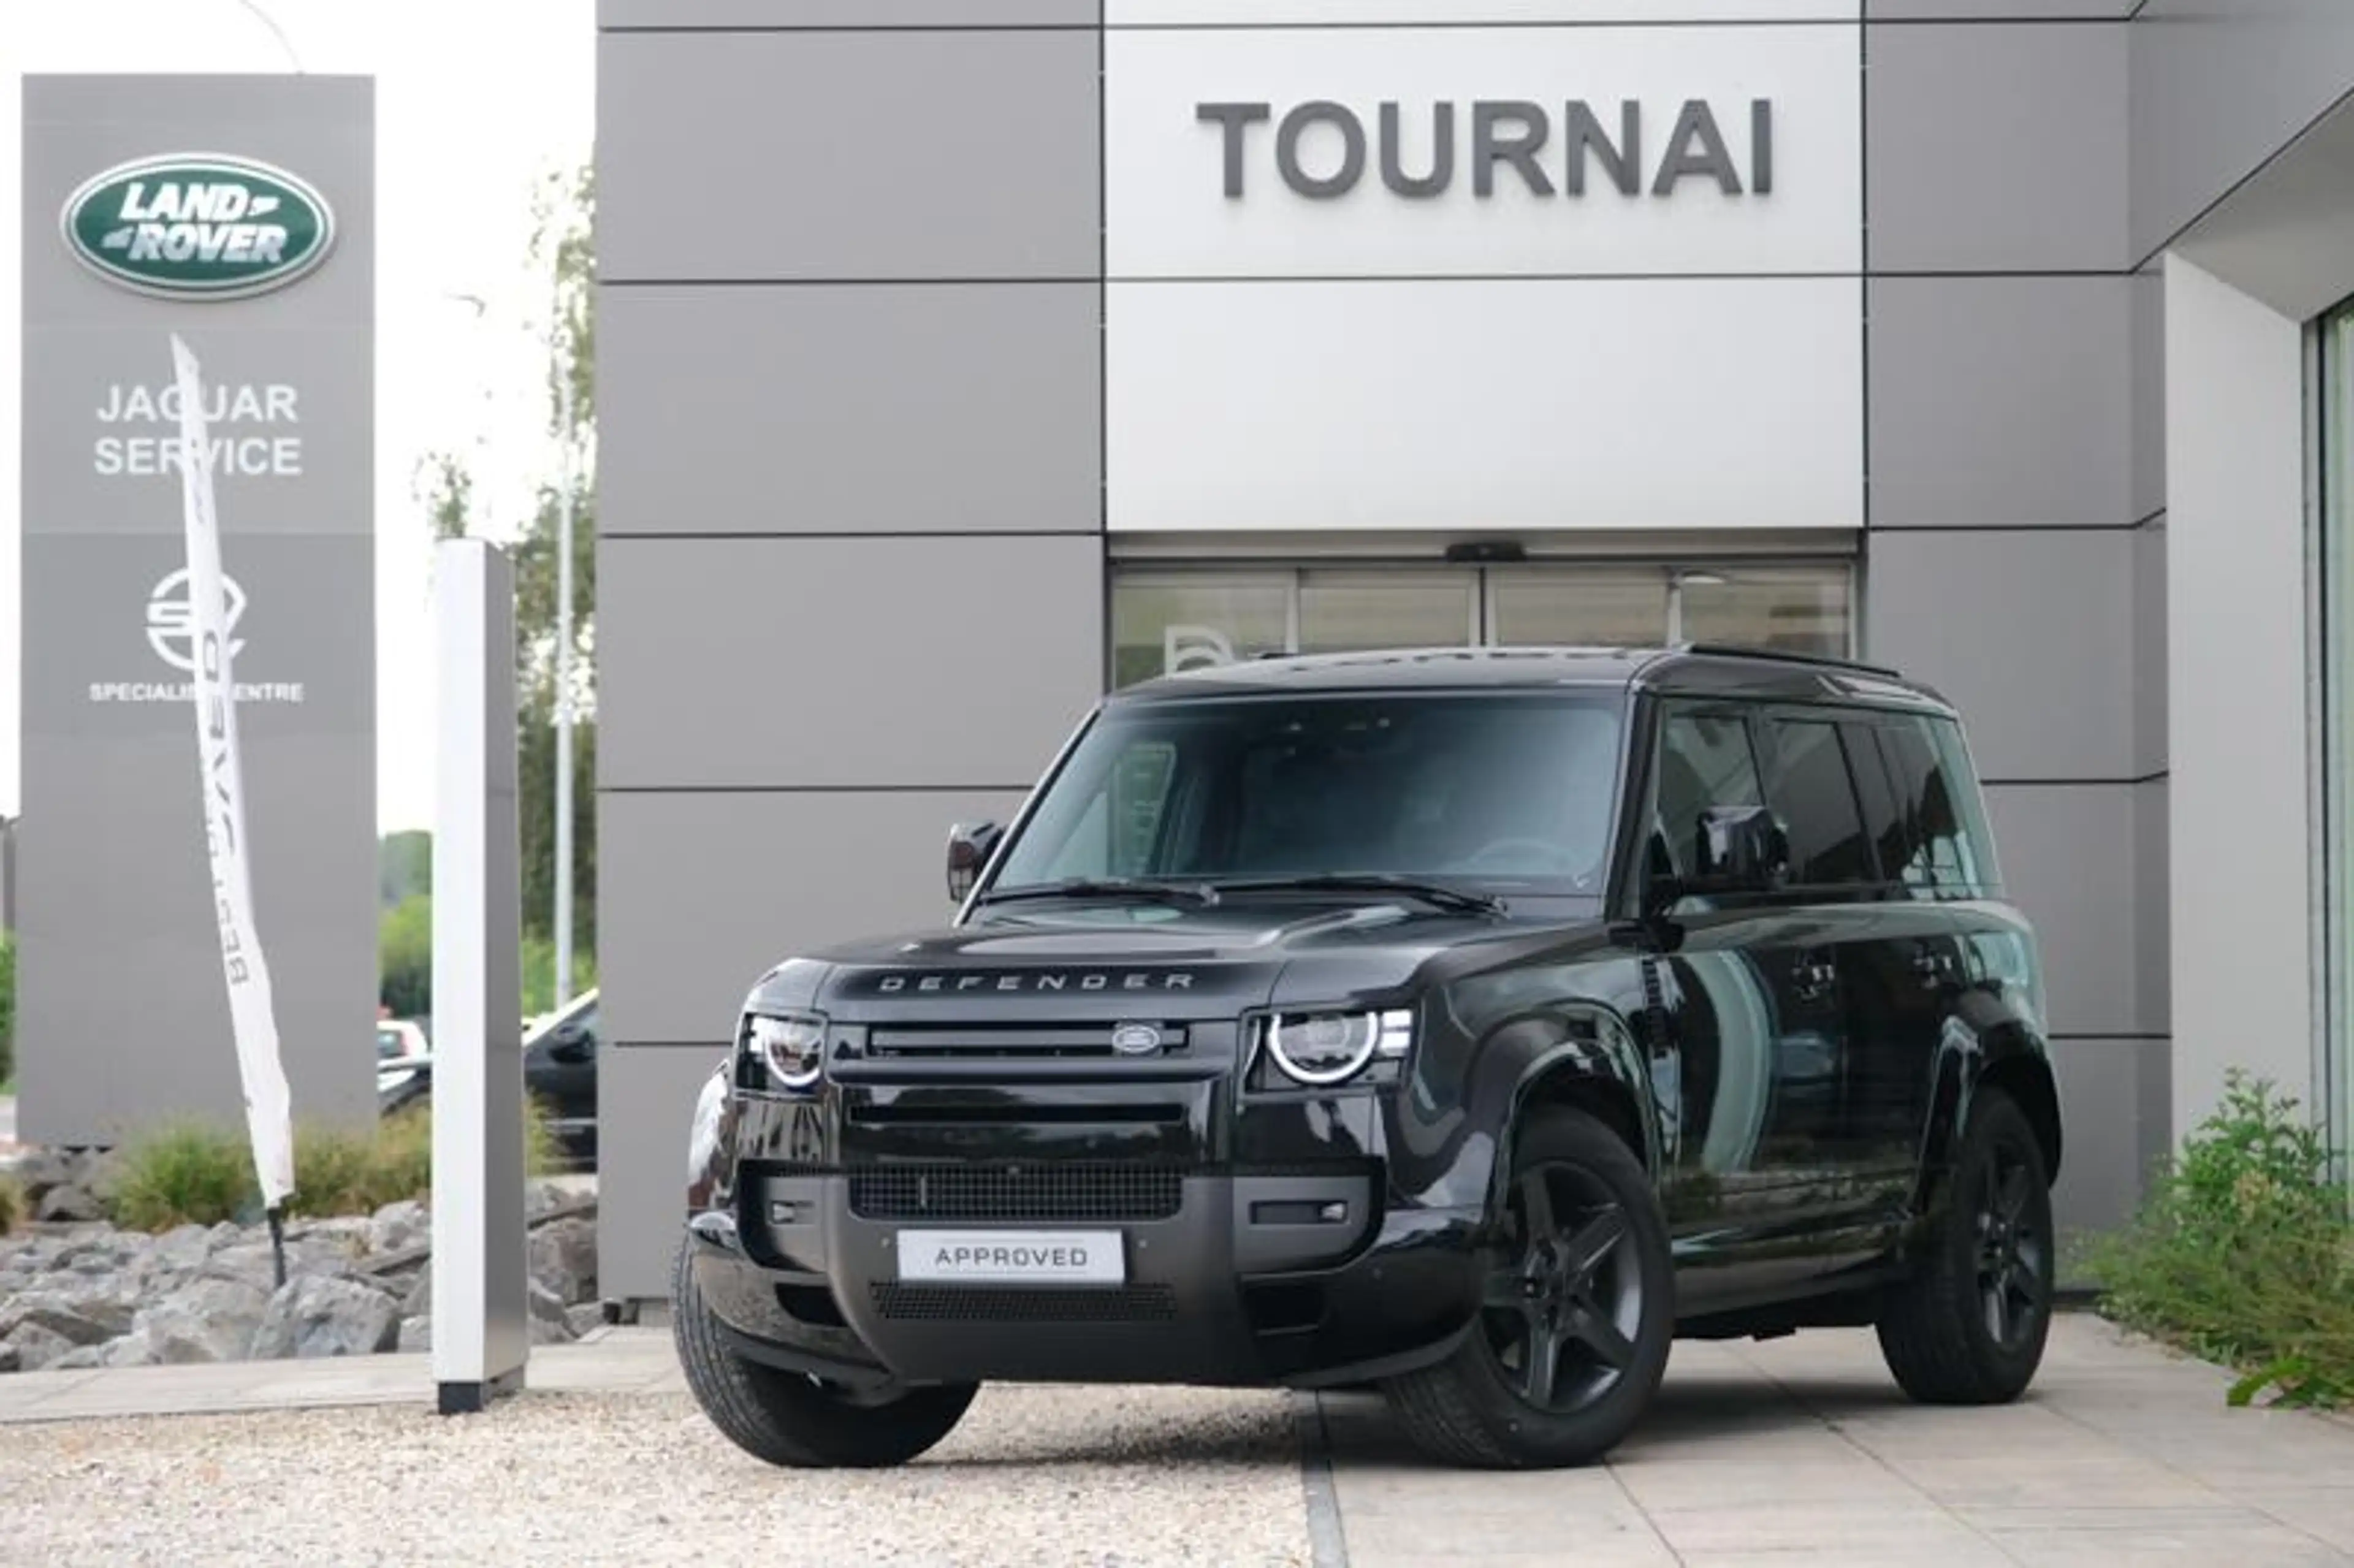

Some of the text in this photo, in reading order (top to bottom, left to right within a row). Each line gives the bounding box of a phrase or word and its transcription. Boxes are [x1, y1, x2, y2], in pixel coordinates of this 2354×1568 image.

[1195, 99, 1773, 199] TOURNAI
[119, 183, 251, 221] LAND
[127, 223, 288, 262] ROVER
[90, 682, 305, 701] SPECIALIS ENTRE
[880, 973, 1194, 991] DEFENDER
[935, 1247, 1089, 1267] APPROVED
